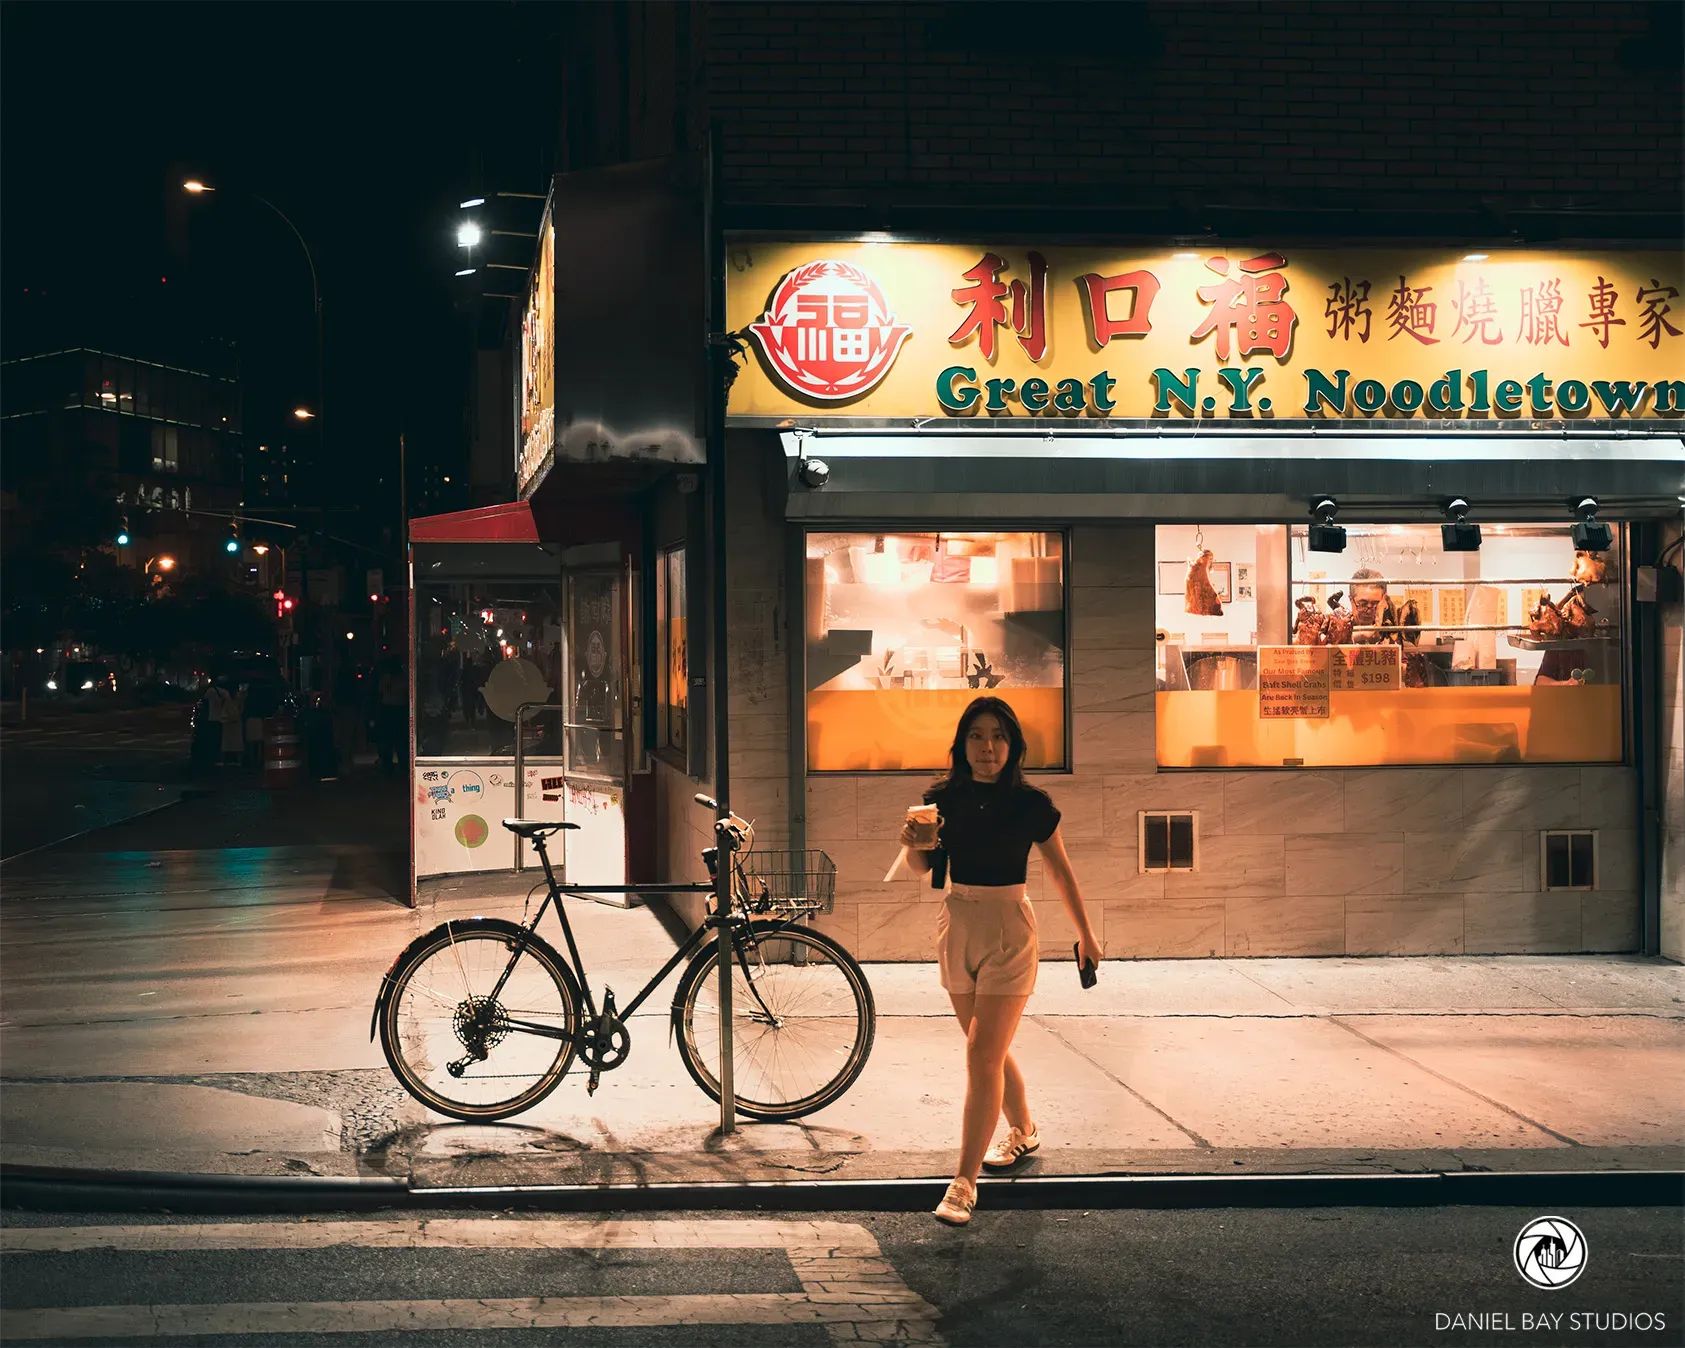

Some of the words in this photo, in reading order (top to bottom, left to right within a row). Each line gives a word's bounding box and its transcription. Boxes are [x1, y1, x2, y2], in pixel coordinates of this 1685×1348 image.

[796, 294, 870, 362] 福
[948, 251, 1298, 363] 利口福
[1325, 275, 1684, 350] 粥麵燒臘專家
[936, 366, 1117, 412] Great
[1153, 367, 1272, 412] N.Y.
[1303, 367, 1685, 413] Noodletown
[1281, 681, 1302, 689] Shell
[1303, 681, 1327, 689] Crabs
[1361, 672, 1390, 684] $198
[462, 784, 480, 793] thing
